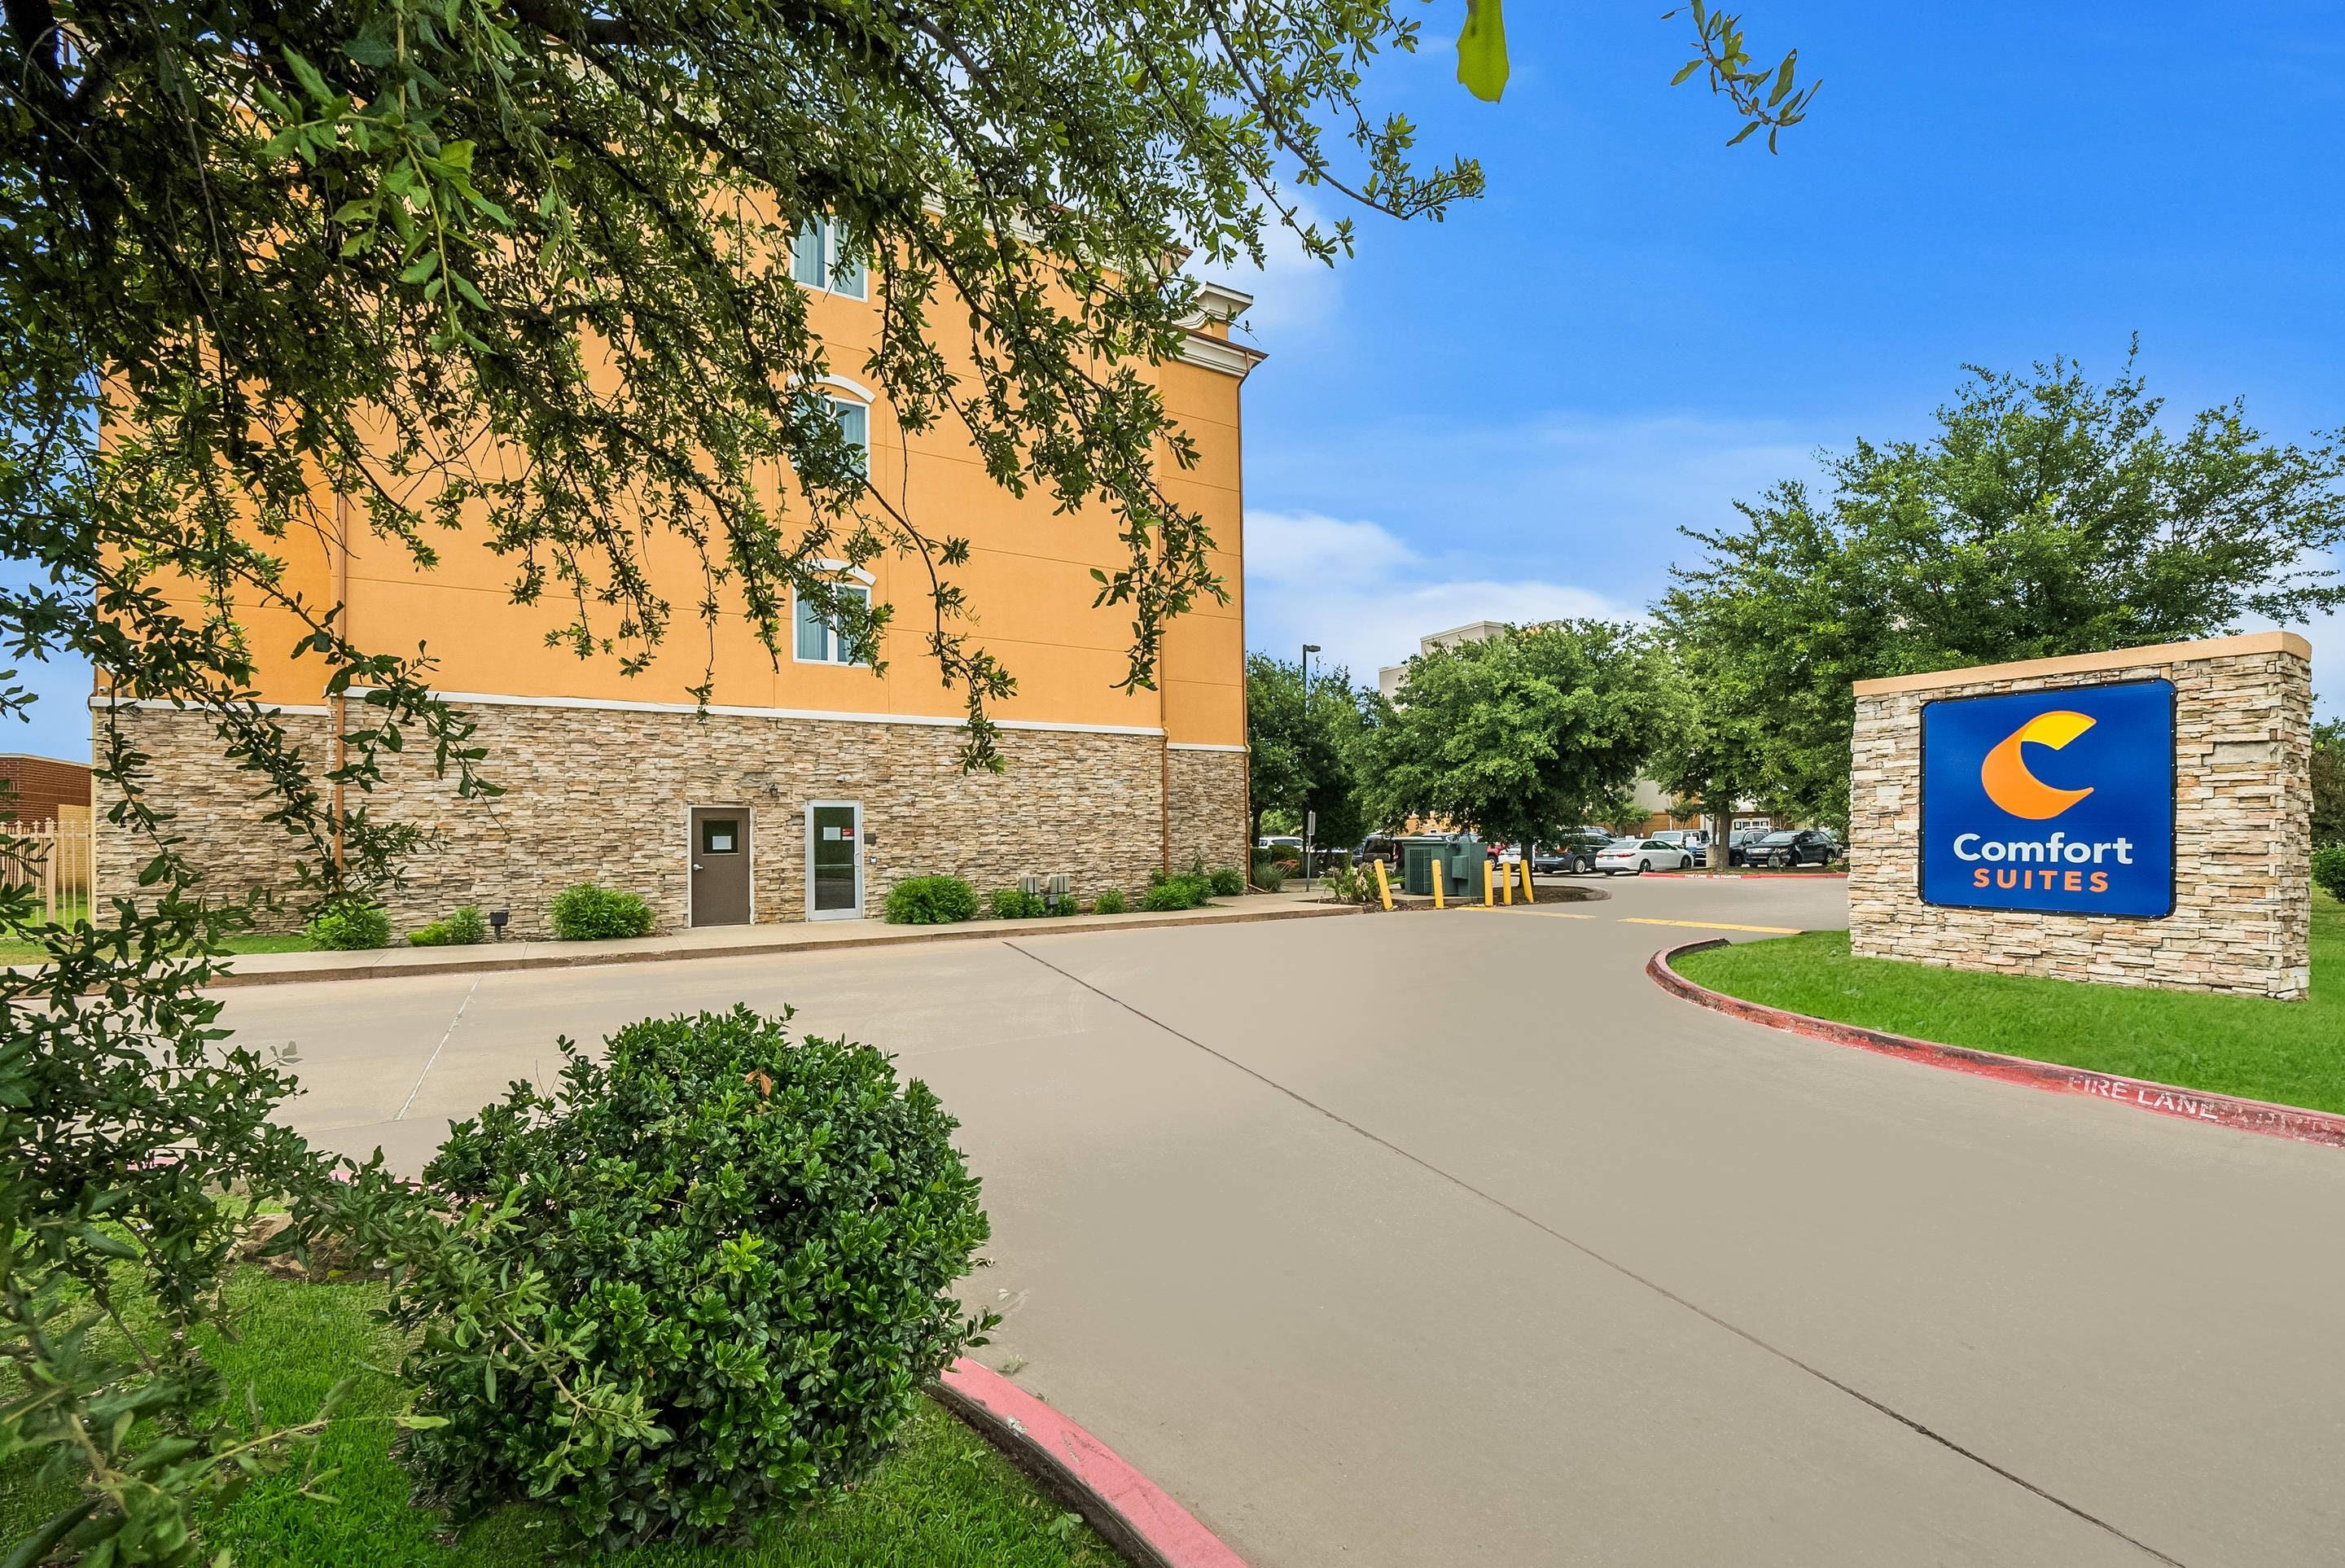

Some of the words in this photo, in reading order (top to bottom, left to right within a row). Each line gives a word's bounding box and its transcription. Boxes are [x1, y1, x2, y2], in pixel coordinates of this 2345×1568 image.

[1953, 831, 2133, 865] Comfort
[1973, 867, 2109, 892] SUITES
[2137, 1088, 2219, 1119] LANE
